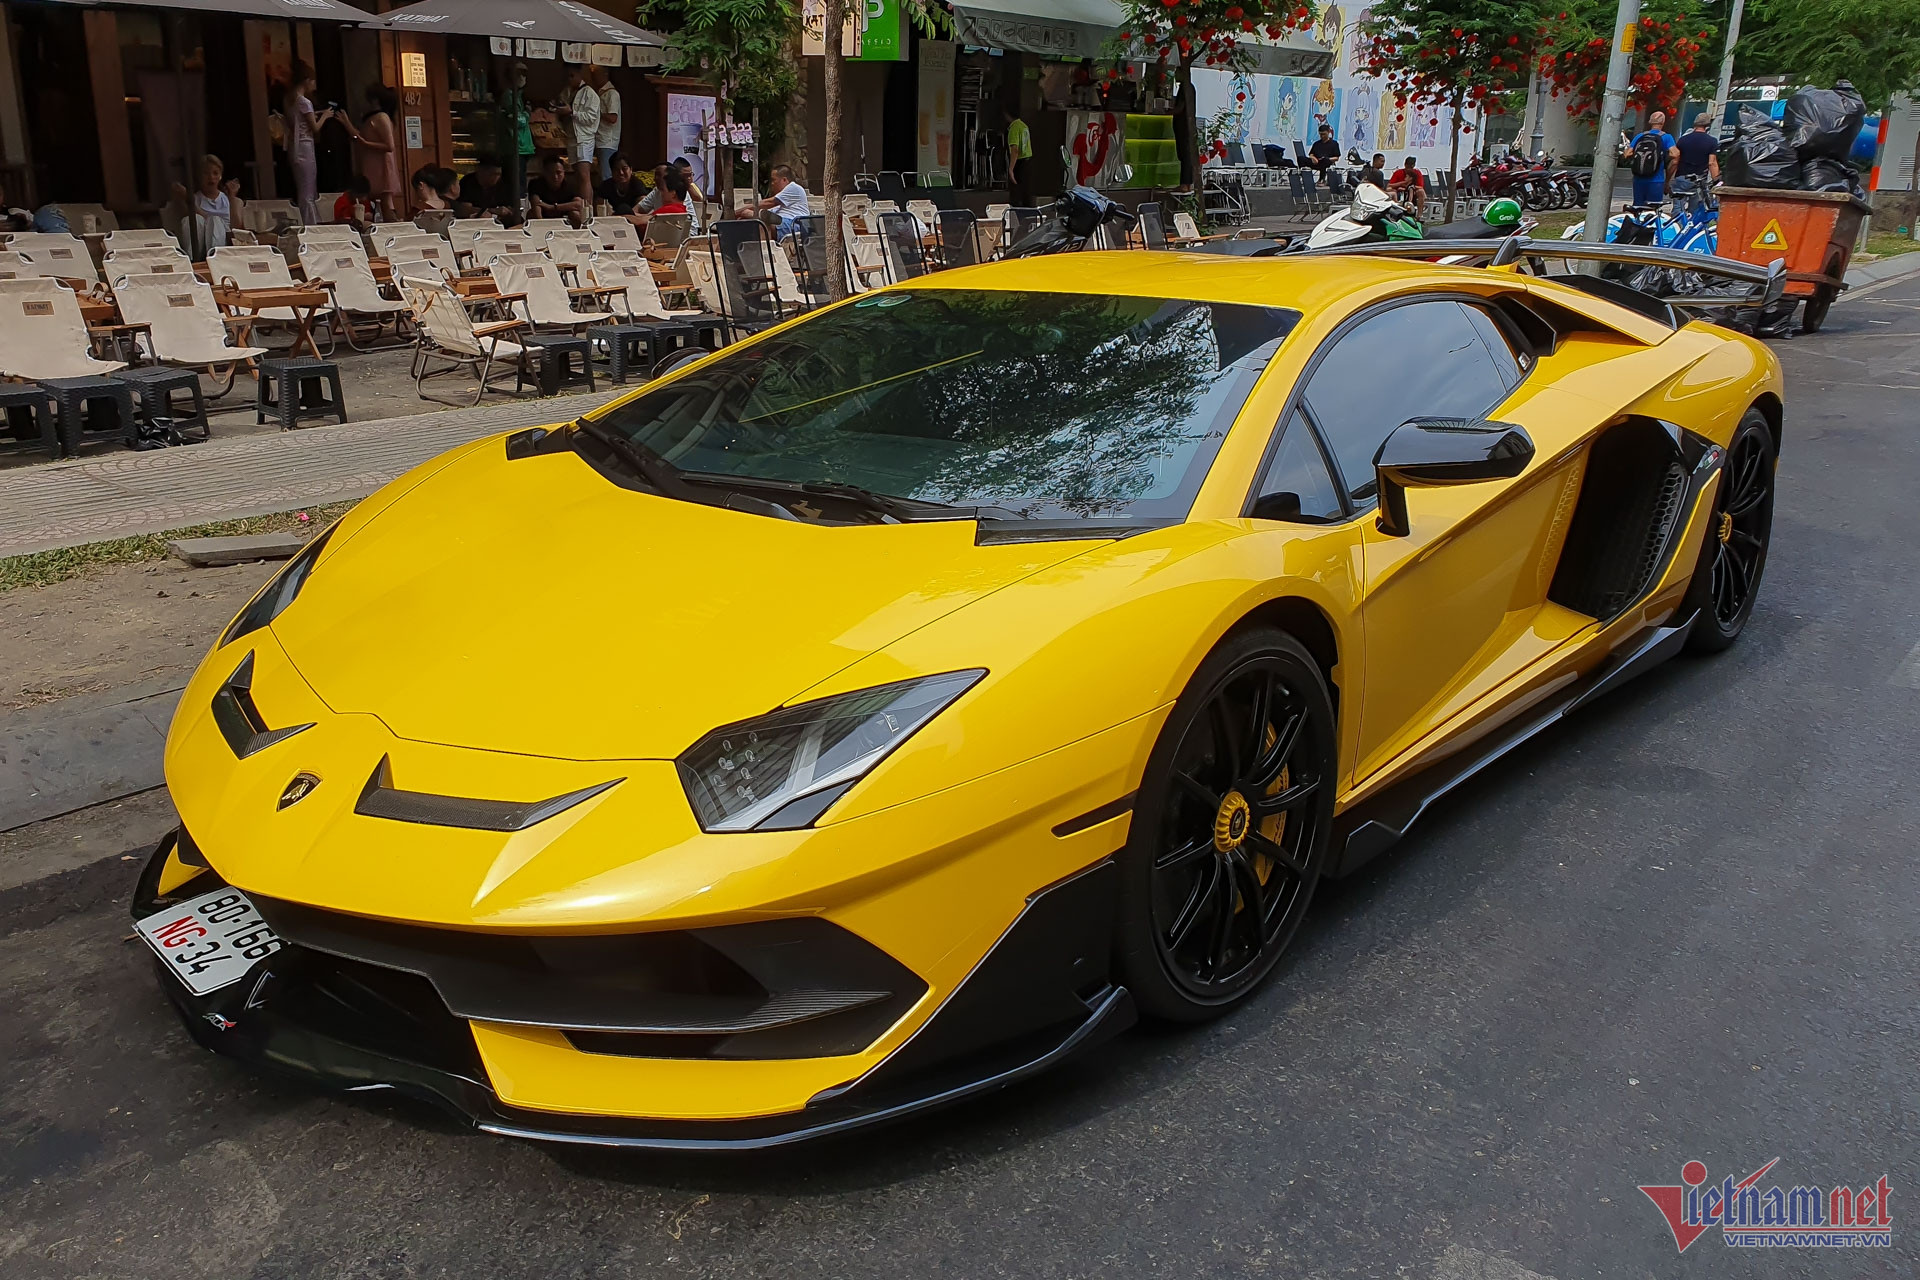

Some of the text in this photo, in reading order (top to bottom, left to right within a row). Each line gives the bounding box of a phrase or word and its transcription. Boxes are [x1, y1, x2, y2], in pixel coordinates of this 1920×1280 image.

[405, 92, 421, 106] 482
[151, 914, 233, 976] NG-34
[197, 894, 282, 960] 80-166
